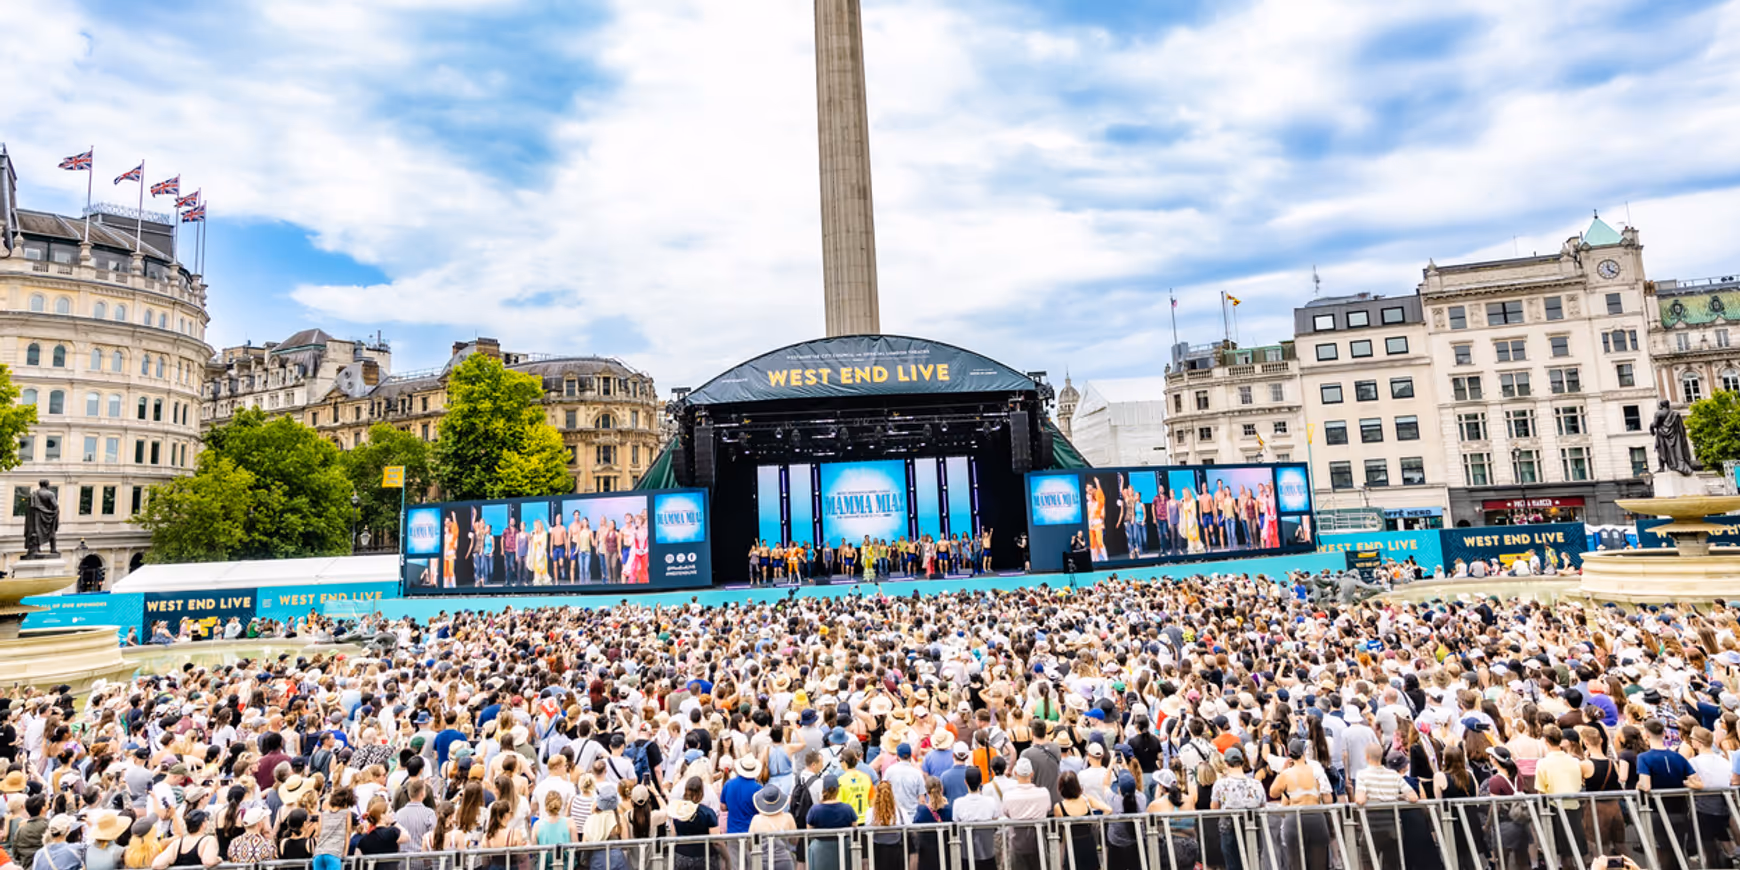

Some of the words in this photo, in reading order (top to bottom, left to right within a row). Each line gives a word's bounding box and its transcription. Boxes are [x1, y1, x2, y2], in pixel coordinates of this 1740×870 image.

[767, 368, 832, 388] WEST
[840, 366, 889, 384] END
[897, 364, 950, 382] LIVE
[825, 495, 873, 516] MAMMA
[875, 493, 905, 513] MIA!
[1407, 509, 1432, 517] NERO
[1316, 543, 1352, 553] WEST
[1356, 541, 1384, 551] END
[1387, 539, 1418, 551] LIVE
[1463, 535, 1499, 547] WEST
[1503, 534, 1531, 545] END
[1534, 532, 1565, 543] LIVE
[146, 600, 184, 612] WEST
[188, 598, 216, 610] END
[220, 597, 251, 609] LIVE
[279, 594, 315, 606] WEST
[320, 592, 348, 604] END
